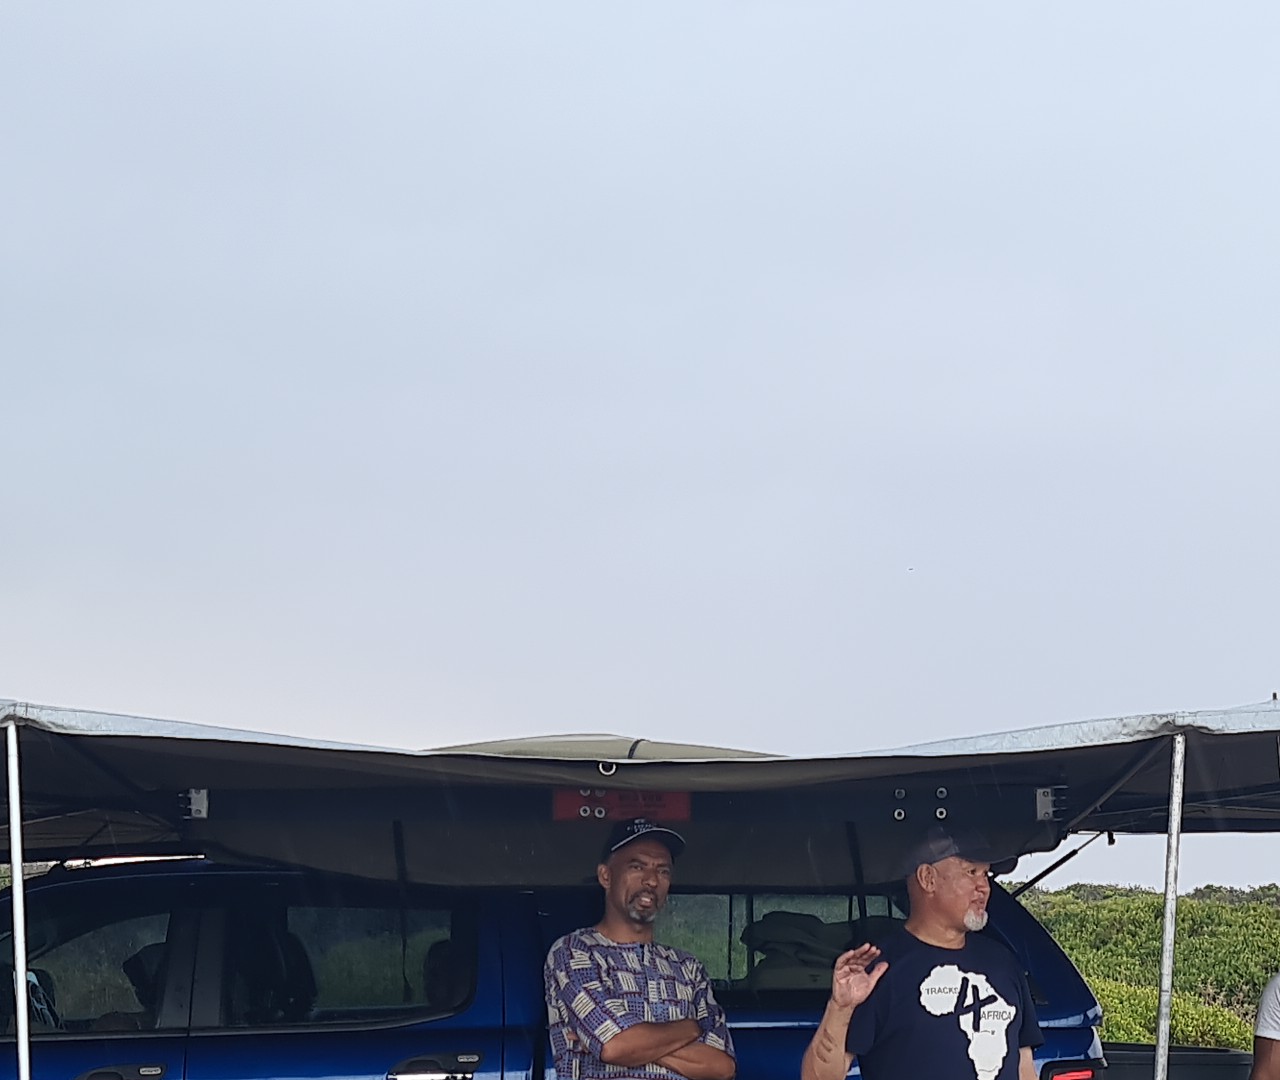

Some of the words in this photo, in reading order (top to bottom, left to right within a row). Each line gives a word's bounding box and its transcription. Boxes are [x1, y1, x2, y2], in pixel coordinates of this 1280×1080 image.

[925, 987, 958, 995] TRACKS
[954, 976, 998, 1033] 4
[981, 1010, 1011, 1021] AFRICA
